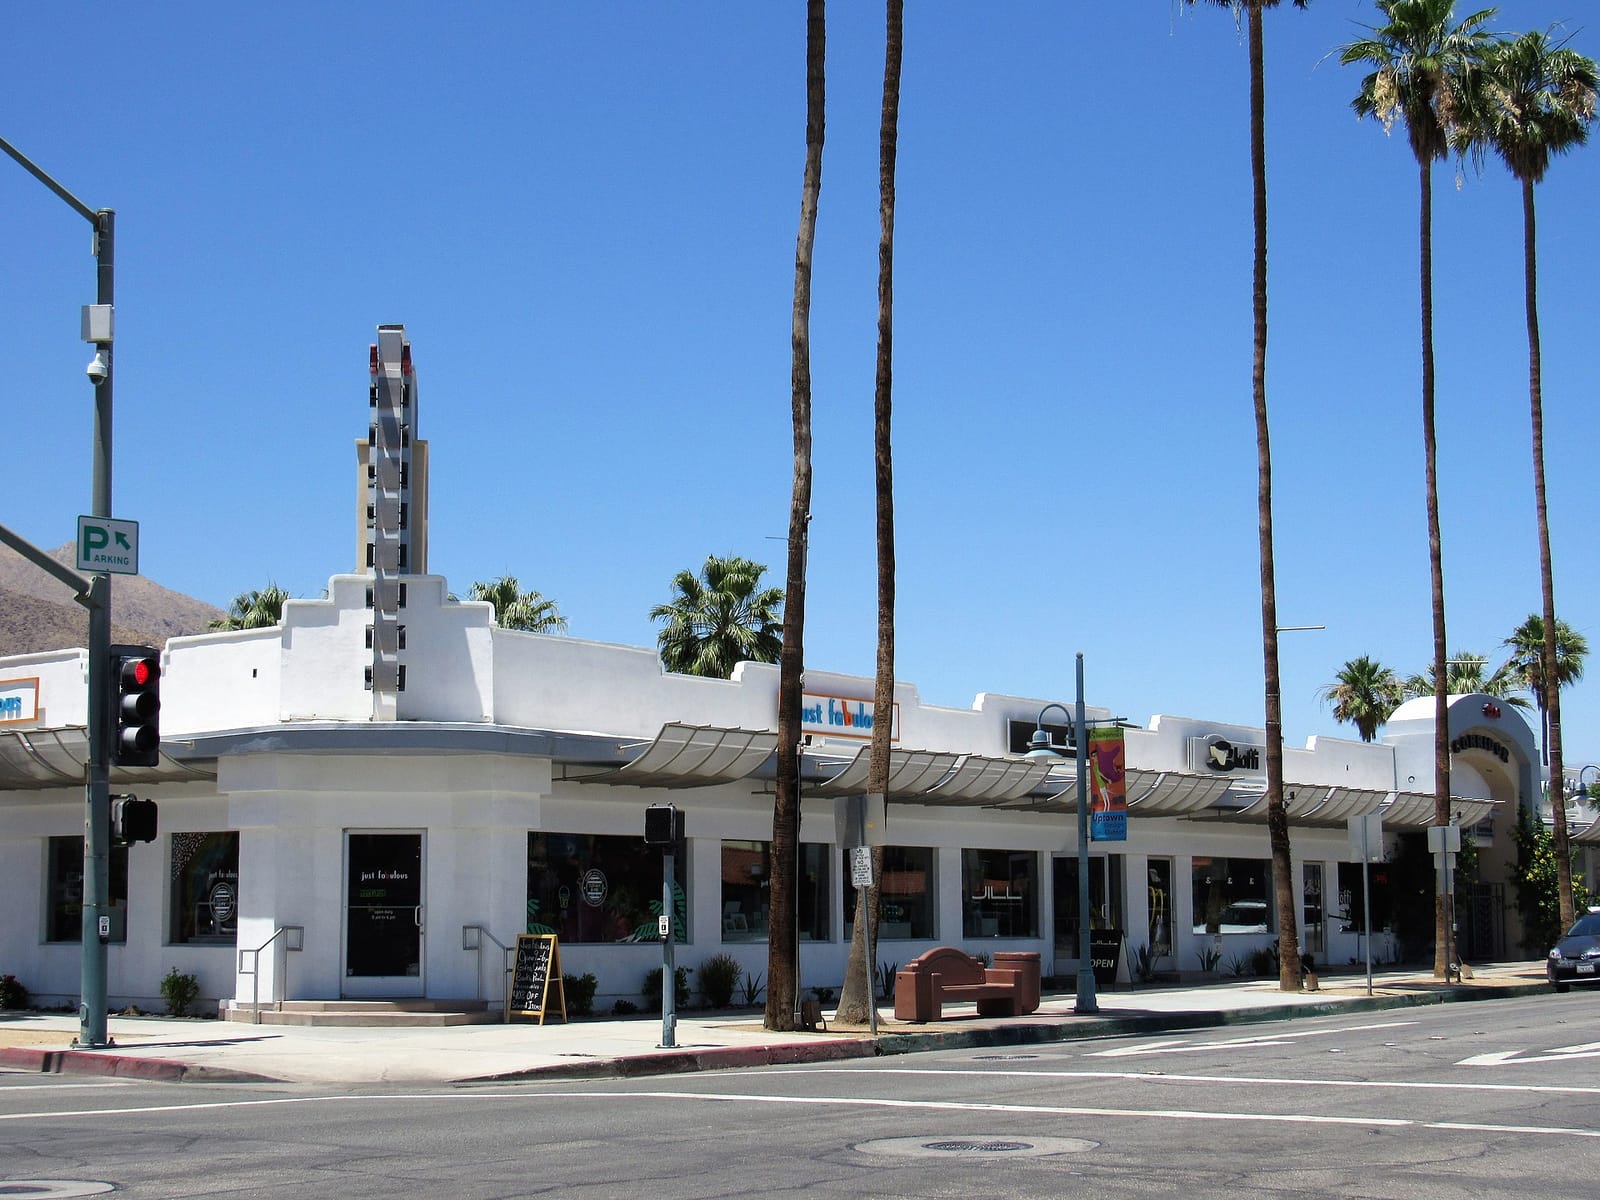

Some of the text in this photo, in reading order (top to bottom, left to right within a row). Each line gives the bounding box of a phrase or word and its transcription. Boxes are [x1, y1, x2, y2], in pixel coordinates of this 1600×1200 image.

[802, 698, 875, 730] ust fabulo
[1451, 734, 1509, 763] CORRIDOR
[1092, 811, 1124, 824] Uptown
[361, 871, 375, 881] just
[972, 886, 1022, 899] JILL
[1090, 959, 1114, 968] OPEN
